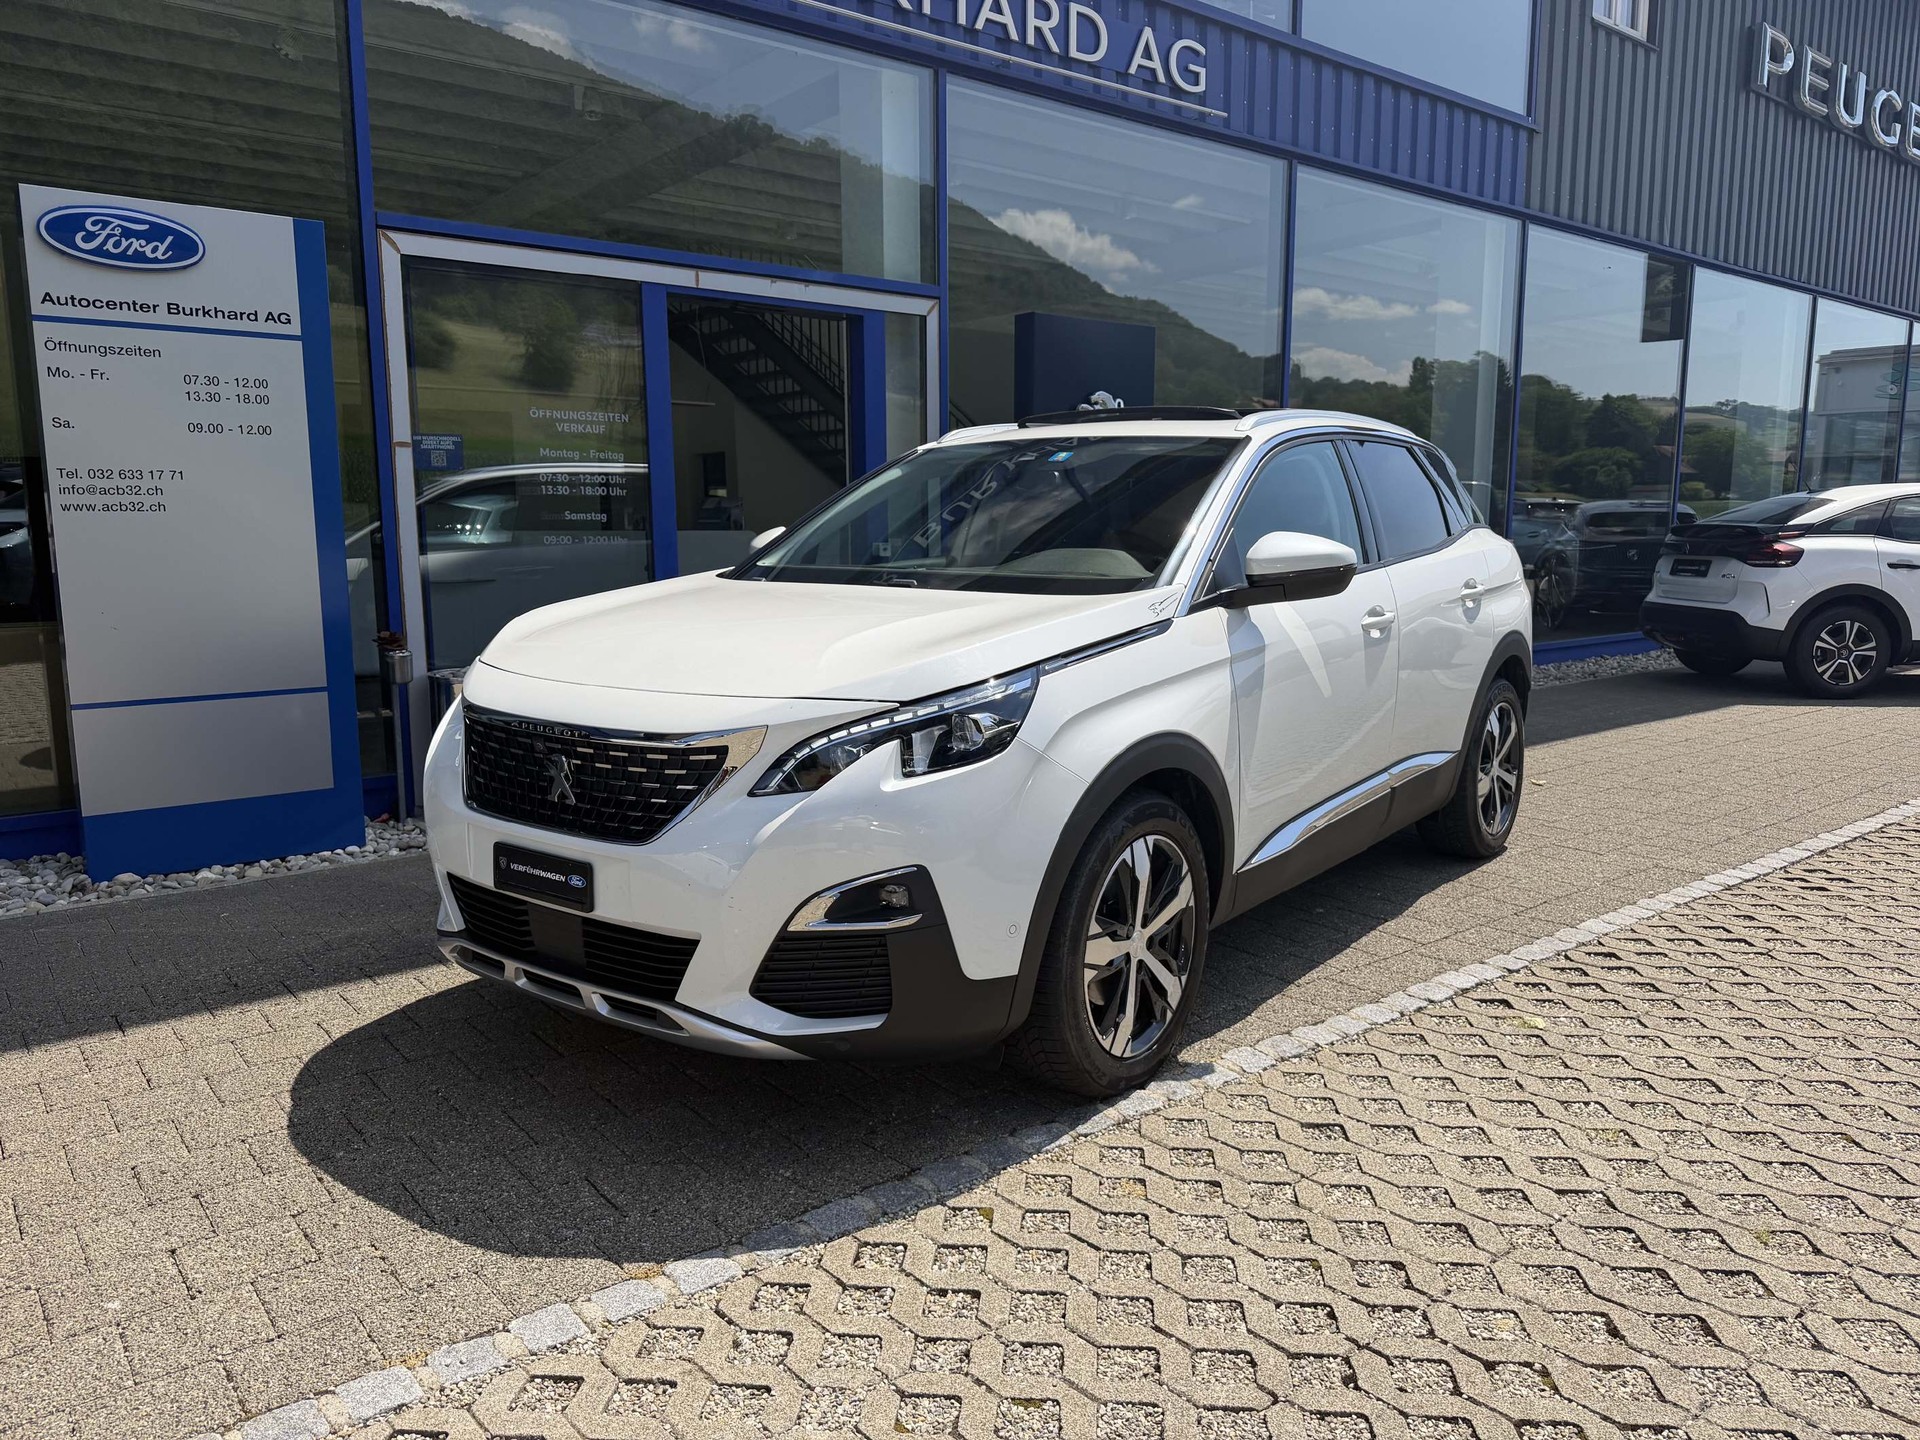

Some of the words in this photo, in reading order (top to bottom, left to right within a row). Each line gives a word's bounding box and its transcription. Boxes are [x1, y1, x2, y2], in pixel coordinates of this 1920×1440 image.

[896, 0, 1108, 62] ARD
[1128, 26, 1206, 93] AG
[75, 216, 174, 261] Ford
[40, 291, 160, 314] Autocenter
[167, 302, 259, 323] Burkhard
[264, 311, 292, 325] AG
[44, 337, 162, 358] Öffnungszeiten
[47, 367, 75, 380] Mo.
[90, 368, 110, 381] Fr.
[183, 374, 220, 387] 07.30
[233, 377, 269, 389] 12.00
[185, 391, 222, 404] 13.30
[235, 393, 270, 405] 18.00
[530, 406, 629, 423] ÖFFNUNGSZEITEN
[52, 417, 75, 429] Sa.
[187, 422, 224, 434] 09.00
[237, 424, 272, 436] 12.00
[556, 422, 606, 434] VERKAUF
[540, 447, 580, 460] Montag
[590, 450, 624, 462] Freitag
[56, 467, 83, 480] Tel.
[87, 468, 114, 480] 032
[118, 469, 144, 481] 633
[148, 469, 164, 481] 17
[169, 470, 185, 481] 71
[540, 473, 569, 482] 07:30
[580, 474, 607, 483] 12:00
[609, 475, 627, 484] Uhr
[58, 484, 164, 498] info@acb32.ch
[541, 485, 569, 495] 13:30
[580, 486, 607, 496] 18:00
[609, 487, 627, 496] Uhr
[60, 501, 167, 513] www.acb32.ch
[564, 510, 607, 522] Samstag
[543, 535, 572, 544] 09:00
[522, 722, 582, 738] PEUGEOT
[510, 862, 566, 882] VERFÜHRWAGEN
